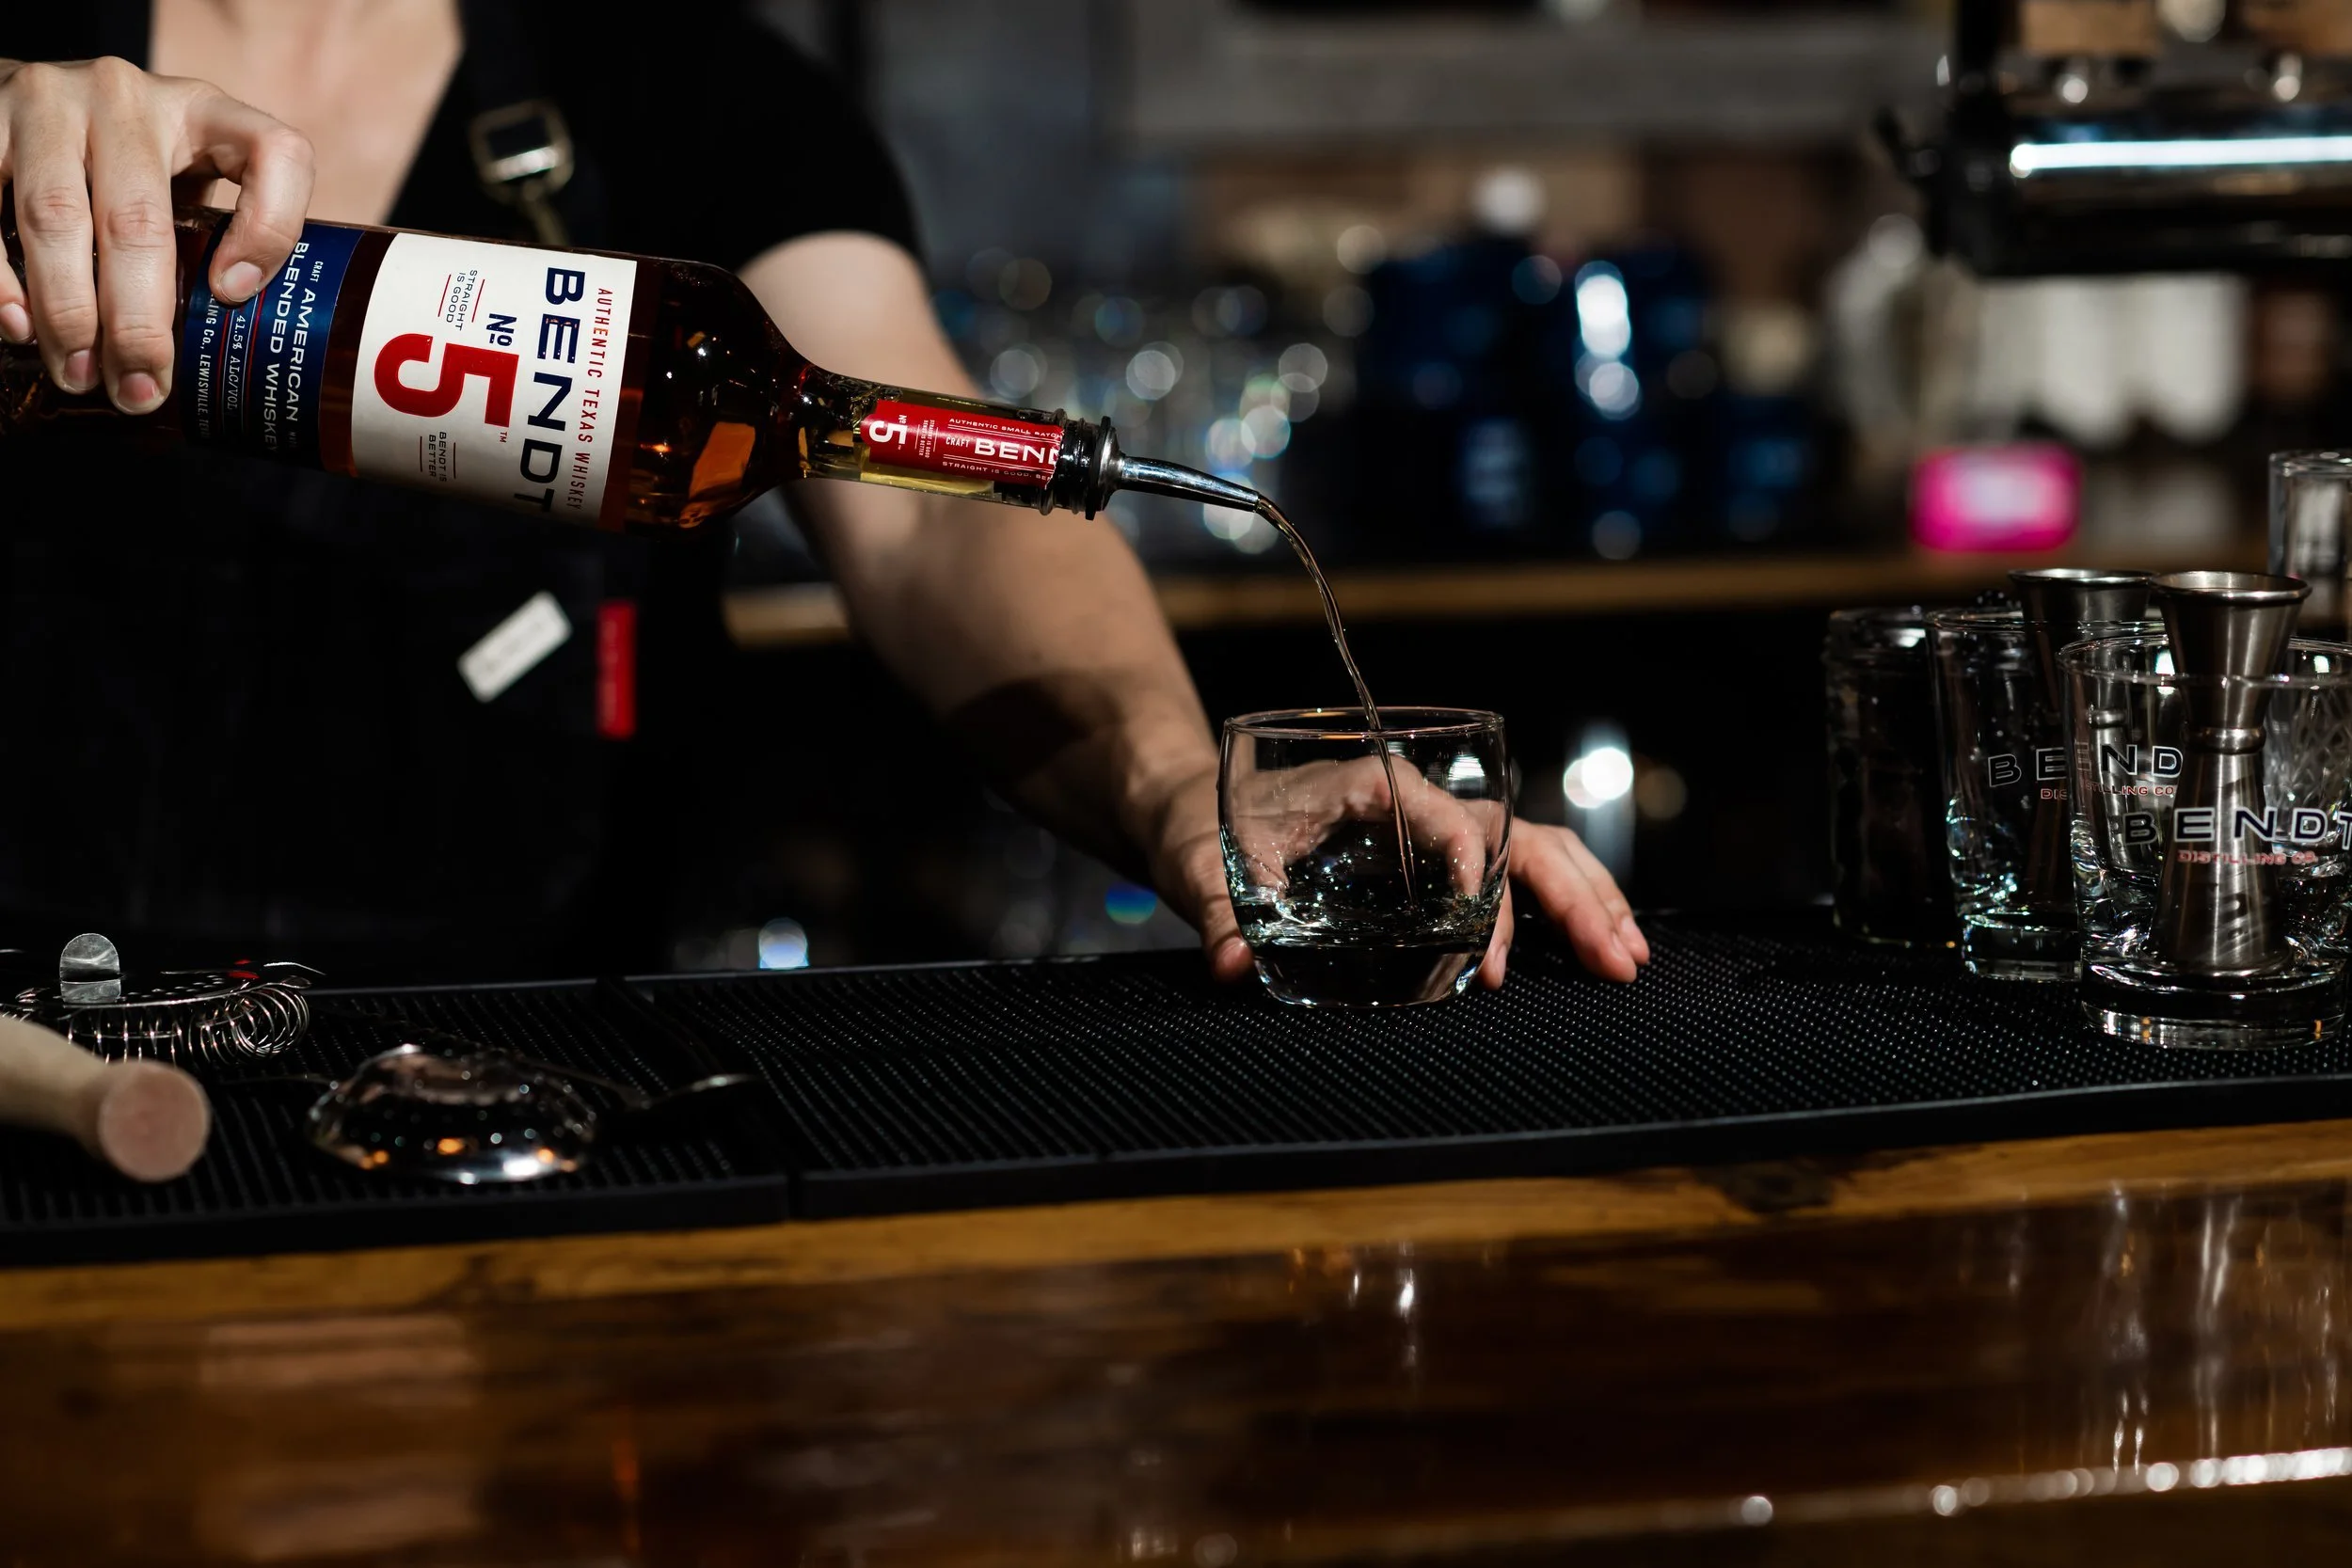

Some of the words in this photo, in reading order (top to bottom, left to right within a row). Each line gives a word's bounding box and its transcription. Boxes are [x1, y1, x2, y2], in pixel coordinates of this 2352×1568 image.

[310, 261, 324, 282] CRAFT
[456, 272, 467, 283] IS
[270, 242, 310, 354] BLENDED
[446, 286, 462, 324] GOOD
[454, 269, 478, 331] STRAIGHT
[231, 315, 246, 349] 41.5%
[587, 288, 613, 378] AUTHENTIC
[286, 288, 316, 421] AMERICAN
[373, 333, 519, 428] 5
[514, 266, 586, 512] BENDT
[263, 363, 280, 452] WHISKEY
[578, 389, 600, 443] TEXAS
[949, 418, 998, 430] AUTHENTIC
[1001, 426, 1031, 435] SMALL
[438, 431, 447, 469] BENDT
[868, 420, 908, 445] 5
[946, 436, 970, 448] CRAFT
[428, 434, 437, 478] BETTER
[942, 461, 988, 472] STRAIGHT
[438, 472, 447, 483] IS
[566, 451, 591, 510] WHISKEY
[2177, 849, 2287, 865] DISTILLING
